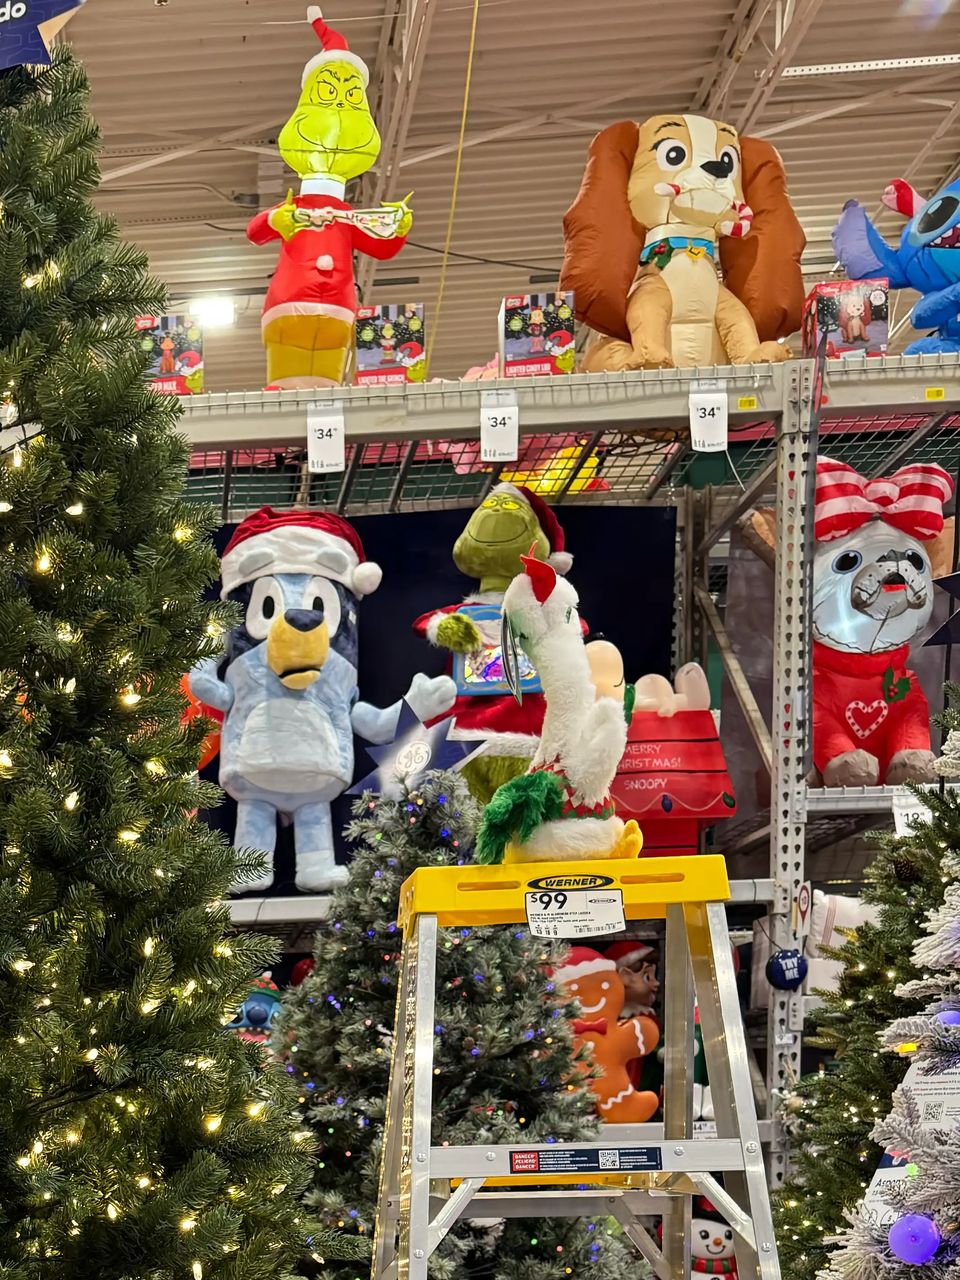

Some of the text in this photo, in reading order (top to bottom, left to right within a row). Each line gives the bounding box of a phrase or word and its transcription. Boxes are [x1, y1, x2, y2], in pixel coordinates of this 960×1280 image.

[624, 777, 668, 790] SNOOPY
[545, 878, 598, 887] WERNER
[531, 892, 568, 911] $99
[781, 957, 799, 971] TRY
[784, 967, 800, 980] ME
